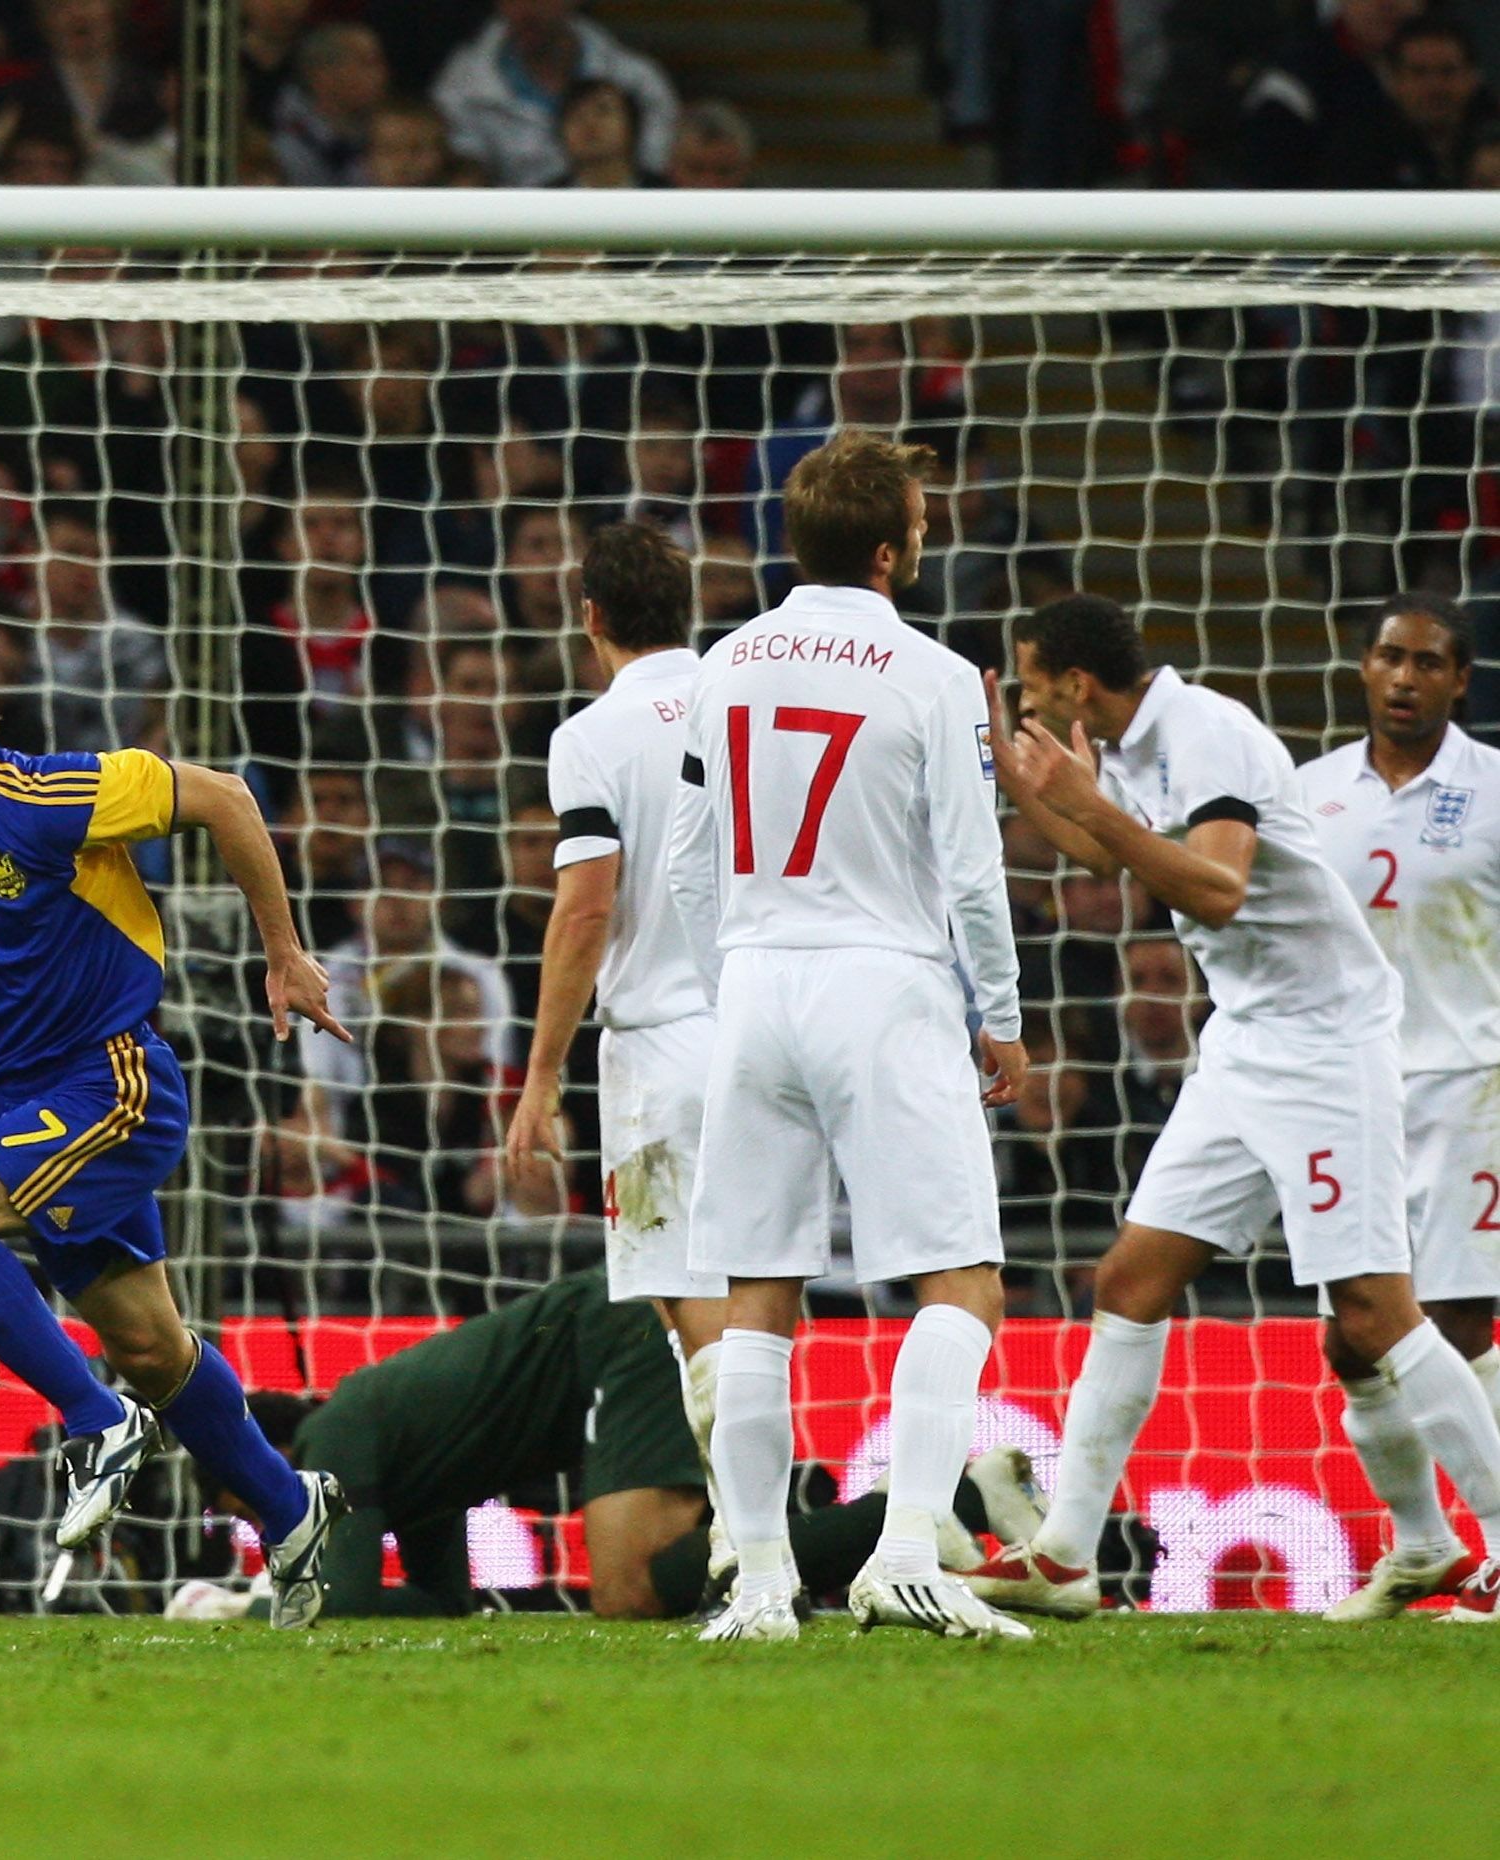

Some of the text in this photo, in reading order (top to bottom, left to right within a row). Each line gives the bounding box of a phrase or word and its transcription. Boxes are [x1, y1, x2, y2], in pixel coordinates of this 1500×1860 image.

[731, 634, 893, 674] BECKHAM
[727, 705, 867, 878] 17
[1368, 848, 1398, 910] 2
[0, 1108, 67, 1148] 7
[1308, 1149, 1341, 1213] 5
[1472, 1170, 1500, 1231] 2
